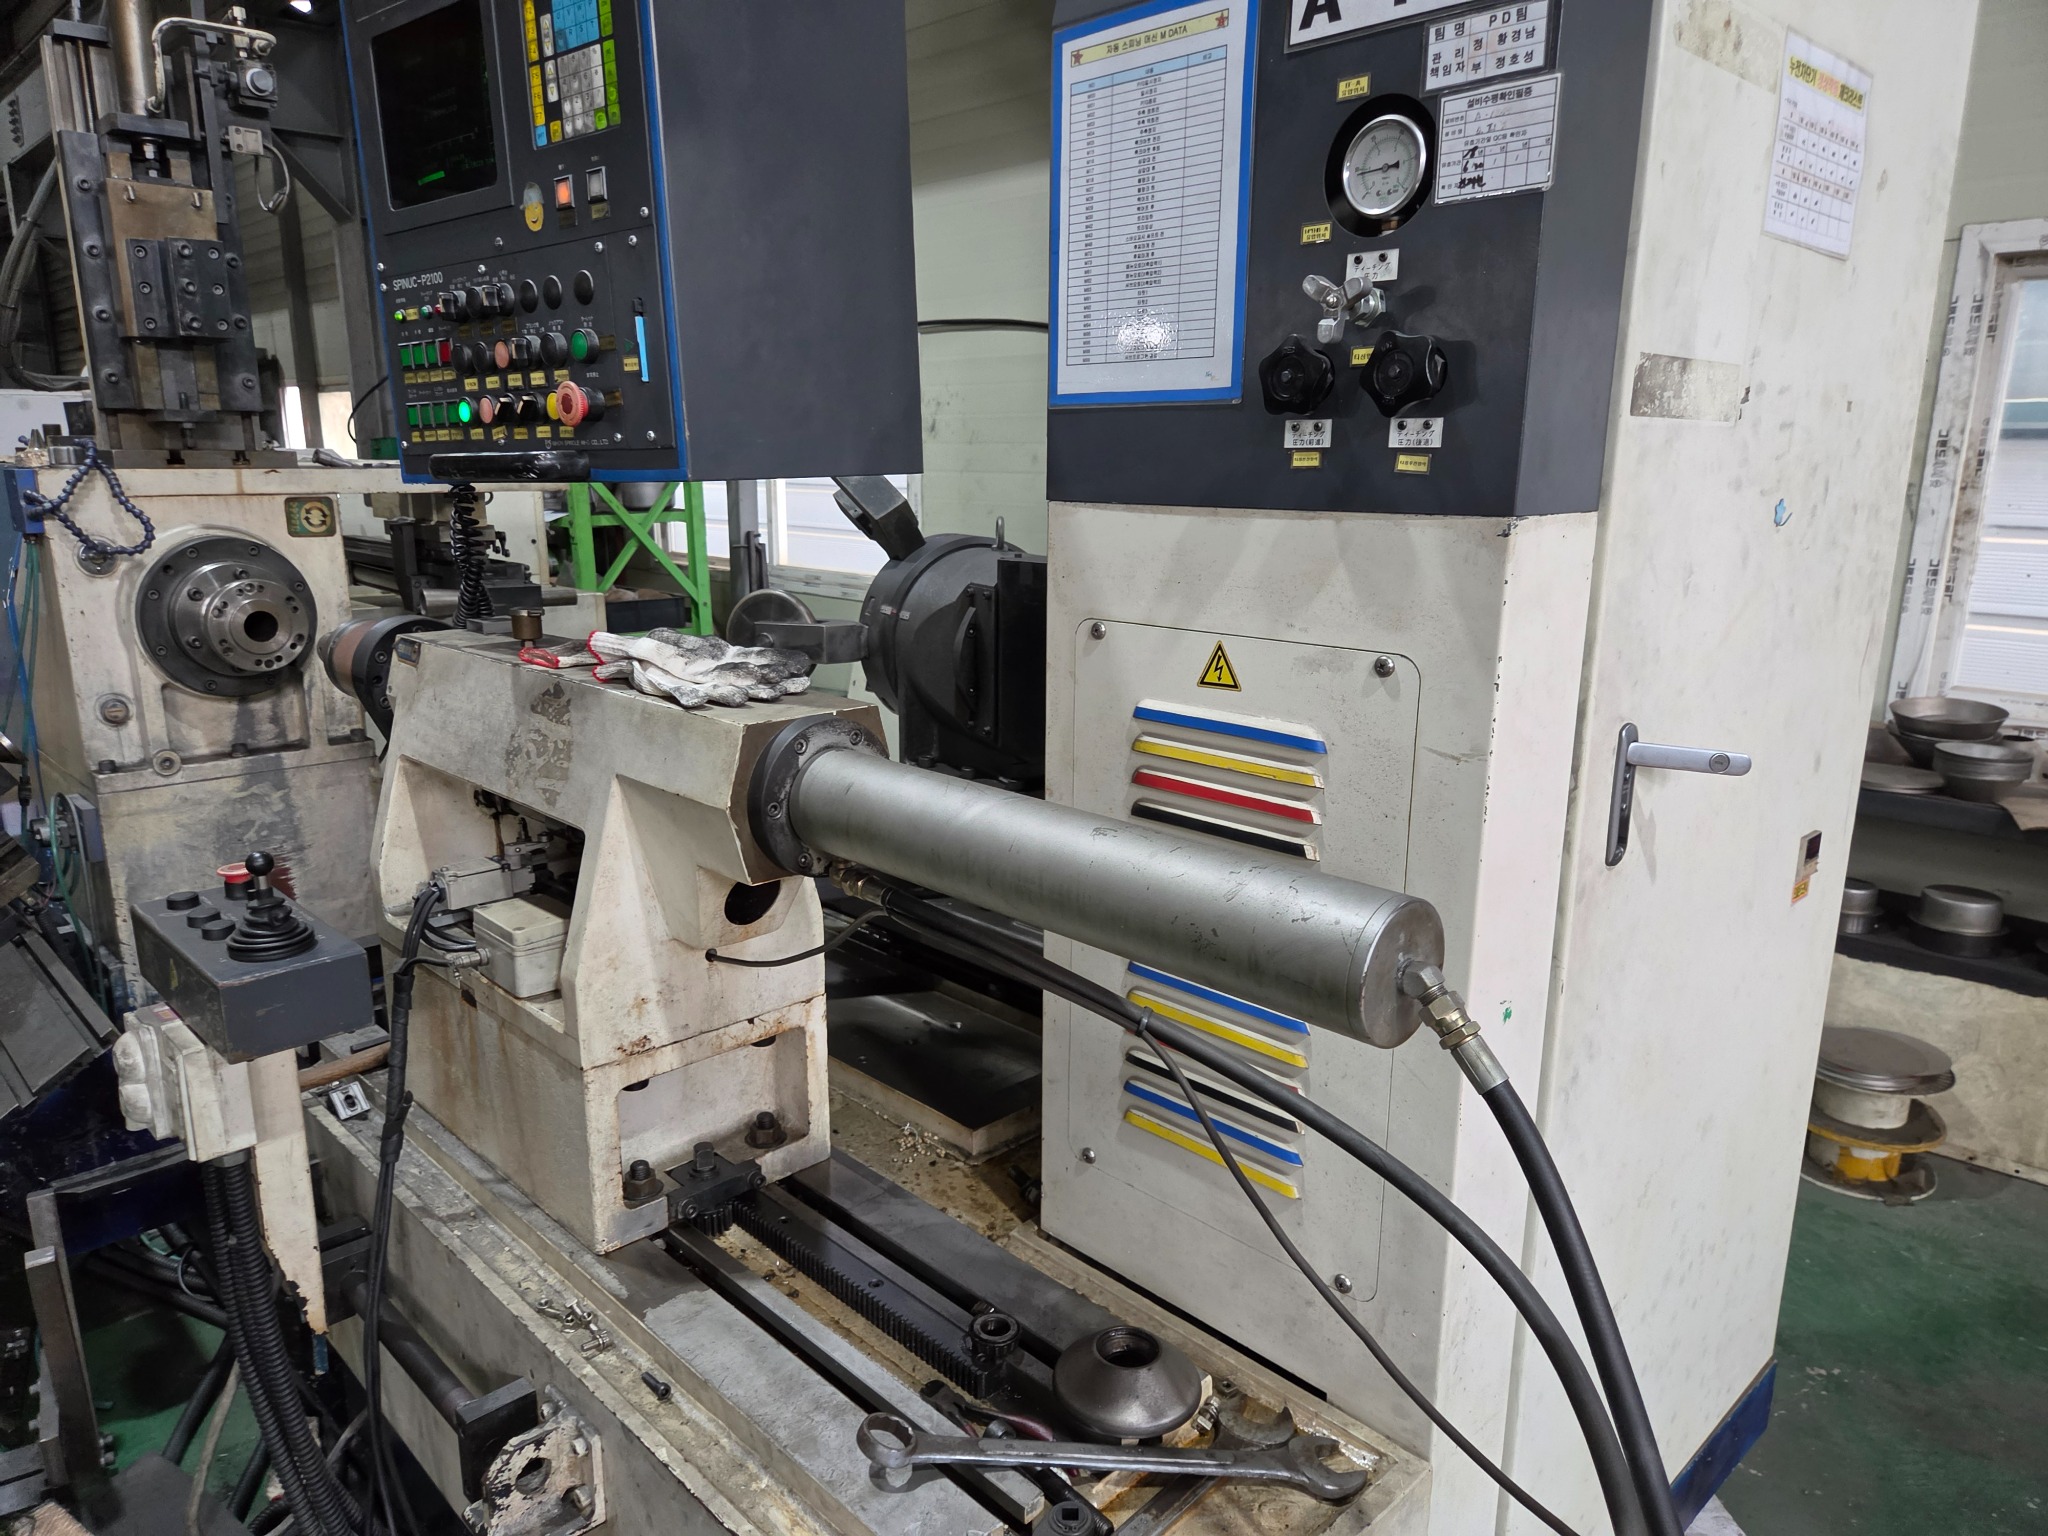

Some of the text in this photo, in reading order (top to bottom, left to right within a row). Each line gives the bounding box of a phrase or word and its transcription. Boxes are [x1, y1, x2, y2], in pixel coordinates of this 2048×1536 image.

[1299, 0, 1342, 31] A
[1121, 38, 1142, 51] 스피닝
[1160, 31, 1167, 40] M
[1168, 25, 1188, 38] DATA
[1473, 37, 1483, 51] 정
[1471, 62, 1482, 74] 부
[1467, 86, 1533, 109] 설비수평확인필증
[393, 271, 443, 291] SPINUC-P2100
